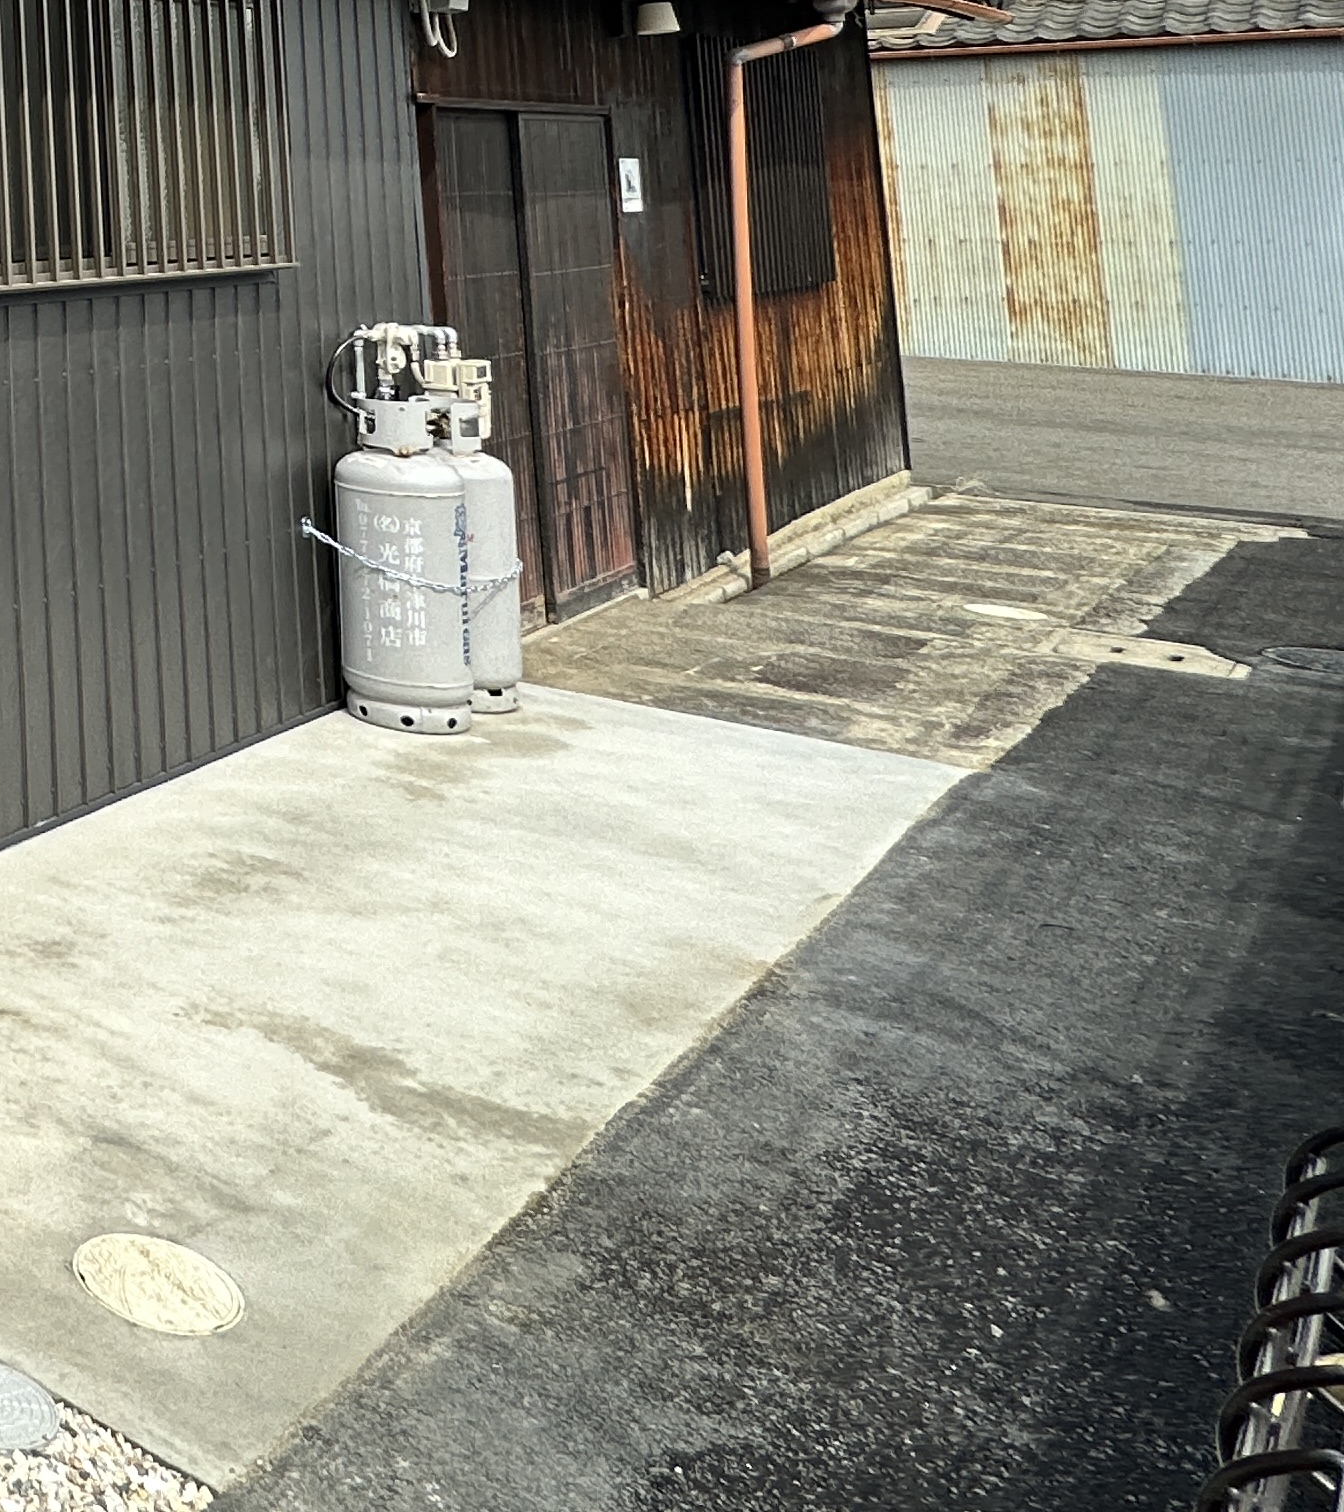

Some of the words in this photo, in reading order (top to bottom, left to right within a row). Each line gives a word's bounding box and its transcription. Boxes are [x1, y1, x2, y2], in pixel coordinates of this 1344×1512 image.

[402, 517, 427, 647] 京都府津川市
